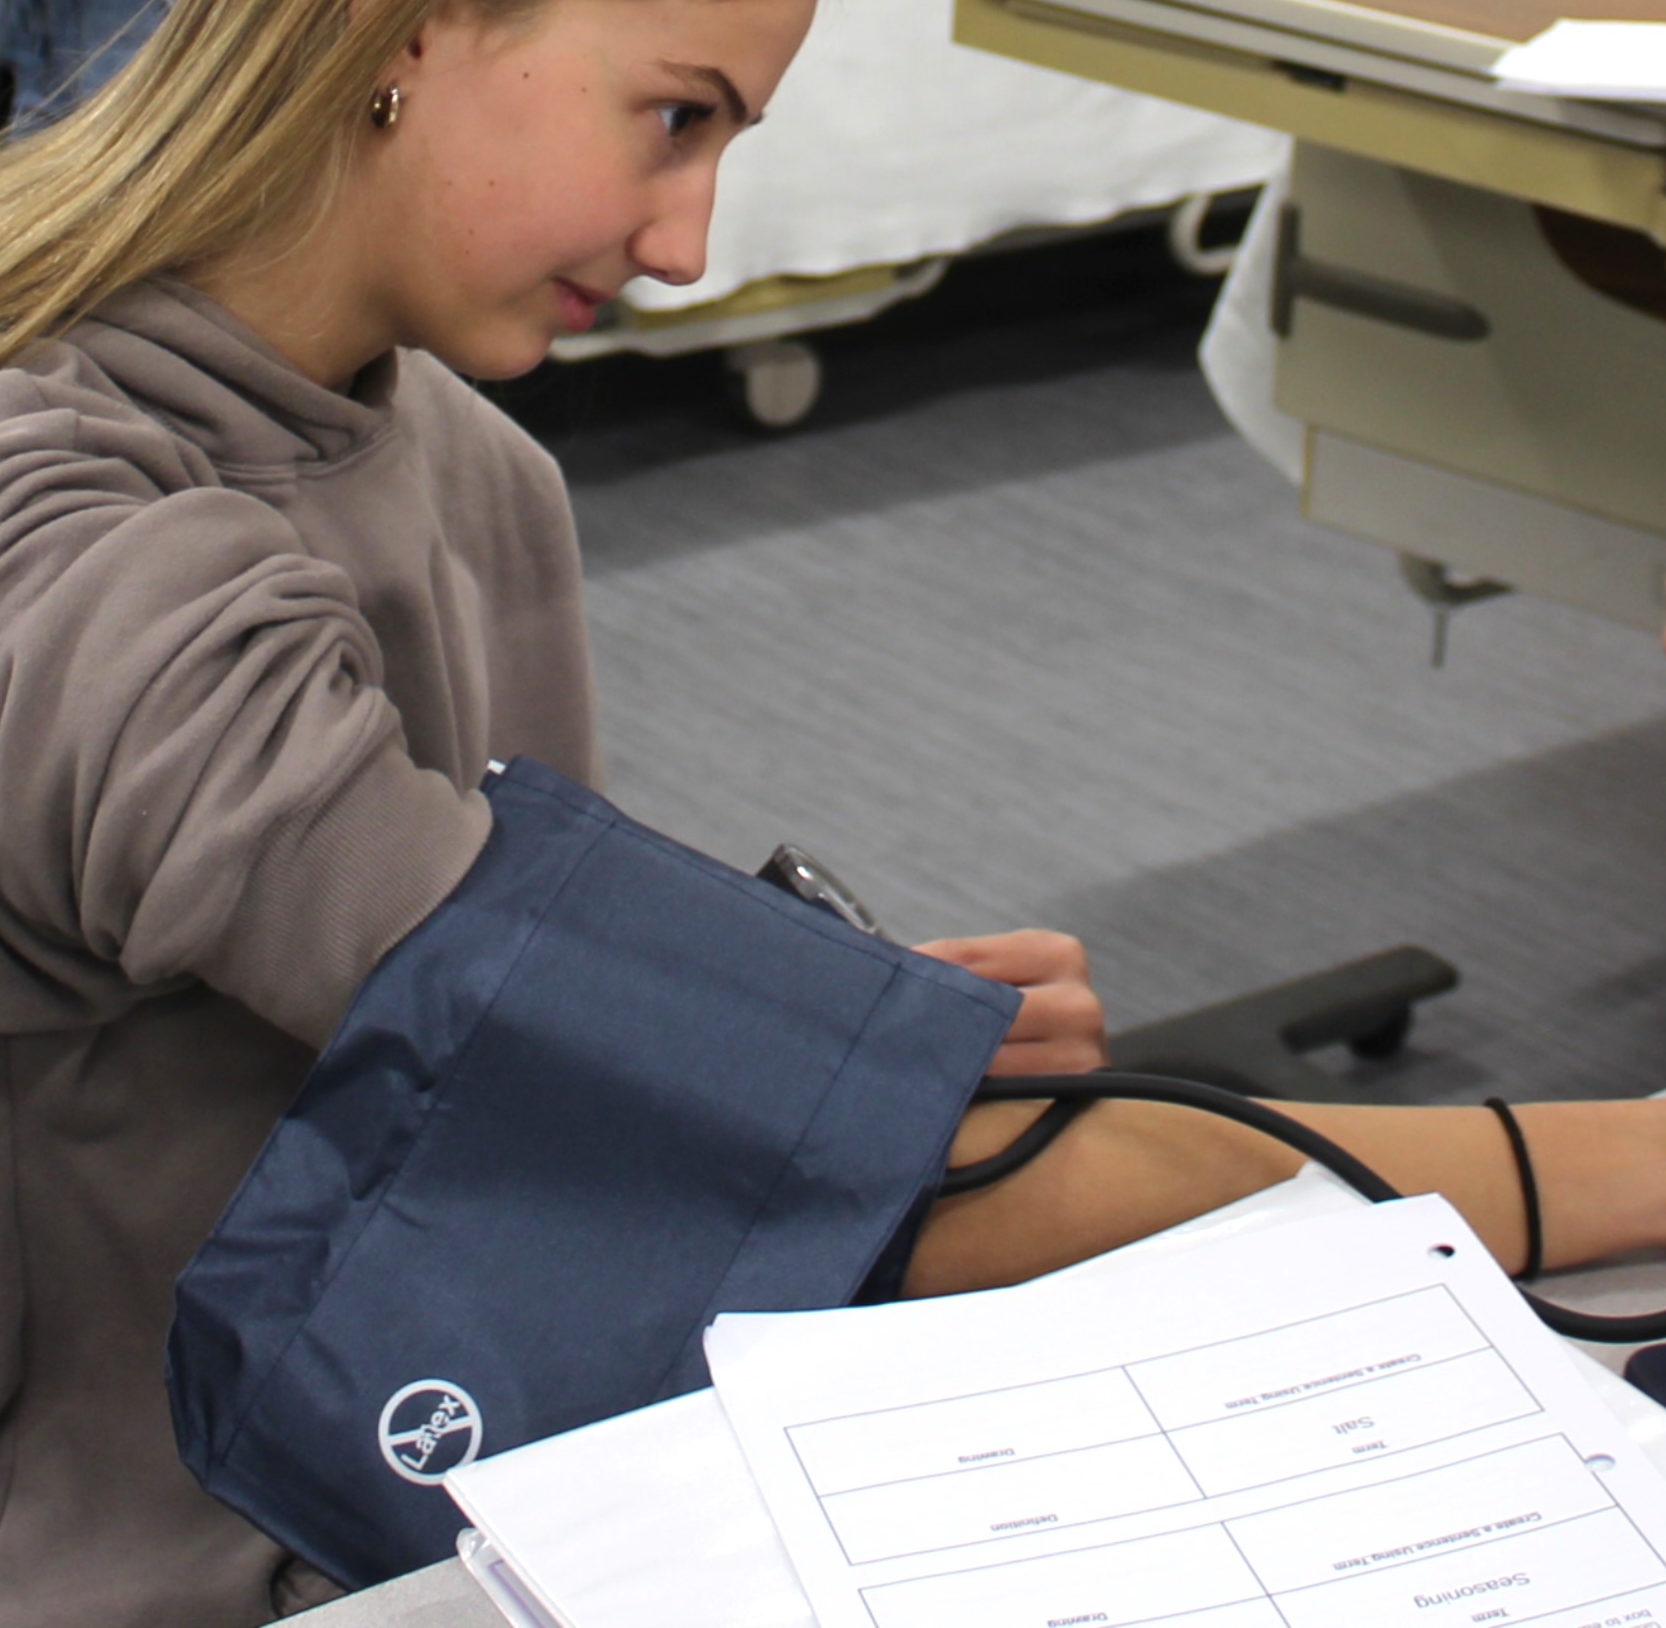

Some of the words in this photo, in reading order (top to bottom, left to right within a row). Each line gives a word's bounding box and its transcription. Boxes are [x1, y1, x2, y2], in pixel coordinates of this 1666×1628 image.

[1377, 1353, 1422, 1371] Create
[1303, 1368, 1365, 1392] Sentence
[1224, 1396, 1260, 1411] Term
[1260, 1387, 1302, 1404] Using
[401, 1394, 460, 1471] Latex
[1332, 1416, 1376, 1436] Salt
[958, 1448, 1015, 1463] Drawing
[1352, 1440, 1389, 1455] Term
[990, 1514, 1059, 1532] Definition
[1496, 1511, 1543, 1531] Create
[1417, 1526, 1482, 1552] Sentence
[1332, 1554, 1371, 1571] Term
[1371, 1544, 1415, 1563] Using
[1413, 1572, 1531, 1609] Seasoning
[1047, 1612, 1108, 1628] Drawing
[1471, 1607, 1511, 1622] Term
[1622, 1608, 1653, 1623] box
